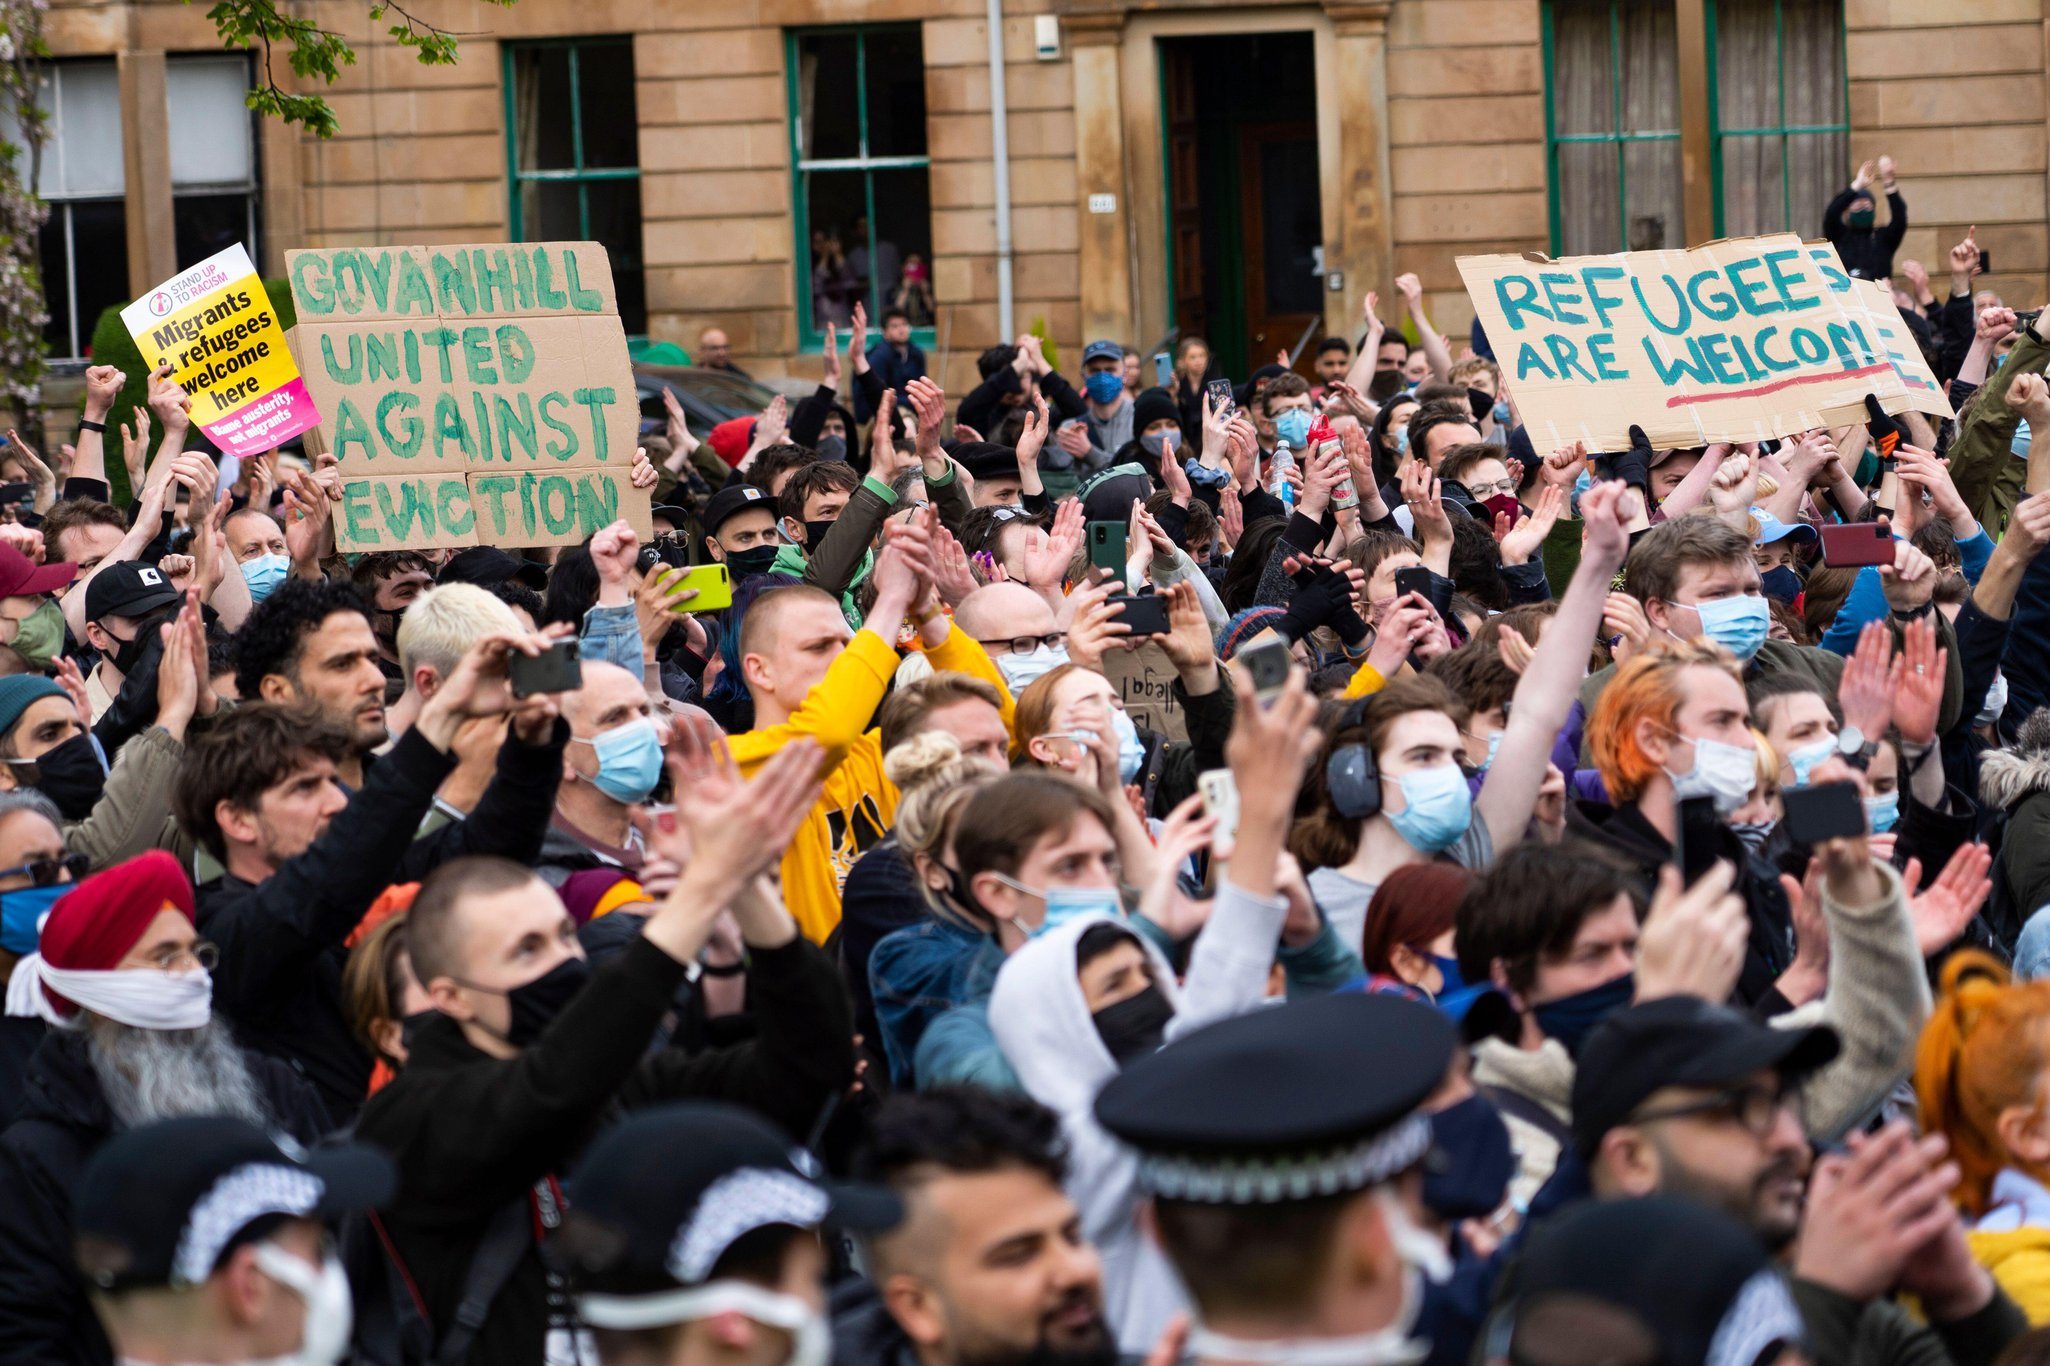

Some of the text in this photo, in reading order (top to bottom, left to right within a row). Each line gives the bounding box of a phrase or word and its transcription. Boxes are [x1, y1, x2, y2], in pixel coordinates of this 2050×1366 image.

[171, 264, 216, 295] STAND UP
[175, 271, 228, 304] TO RACISM
[292, 246, 604, 316] GOVANHILL
[1494, 249, 1852, 336] REFUGEES
[152, 291, 252, 351] Migrants
[157, 311, 272, 379] & refugees
[180, 341, 270, 397] welcome
[320, 323, 536, 385] UNITED
[1517, 332, 1629, 384] ARE
[209, 376, 260, 411] here
[228, 433, 248, 445] not
[245, 408, 292, 439] migrants
[333, 386, 617, 462] AGAINST
[341, 471, 619, 544] EVICTION
